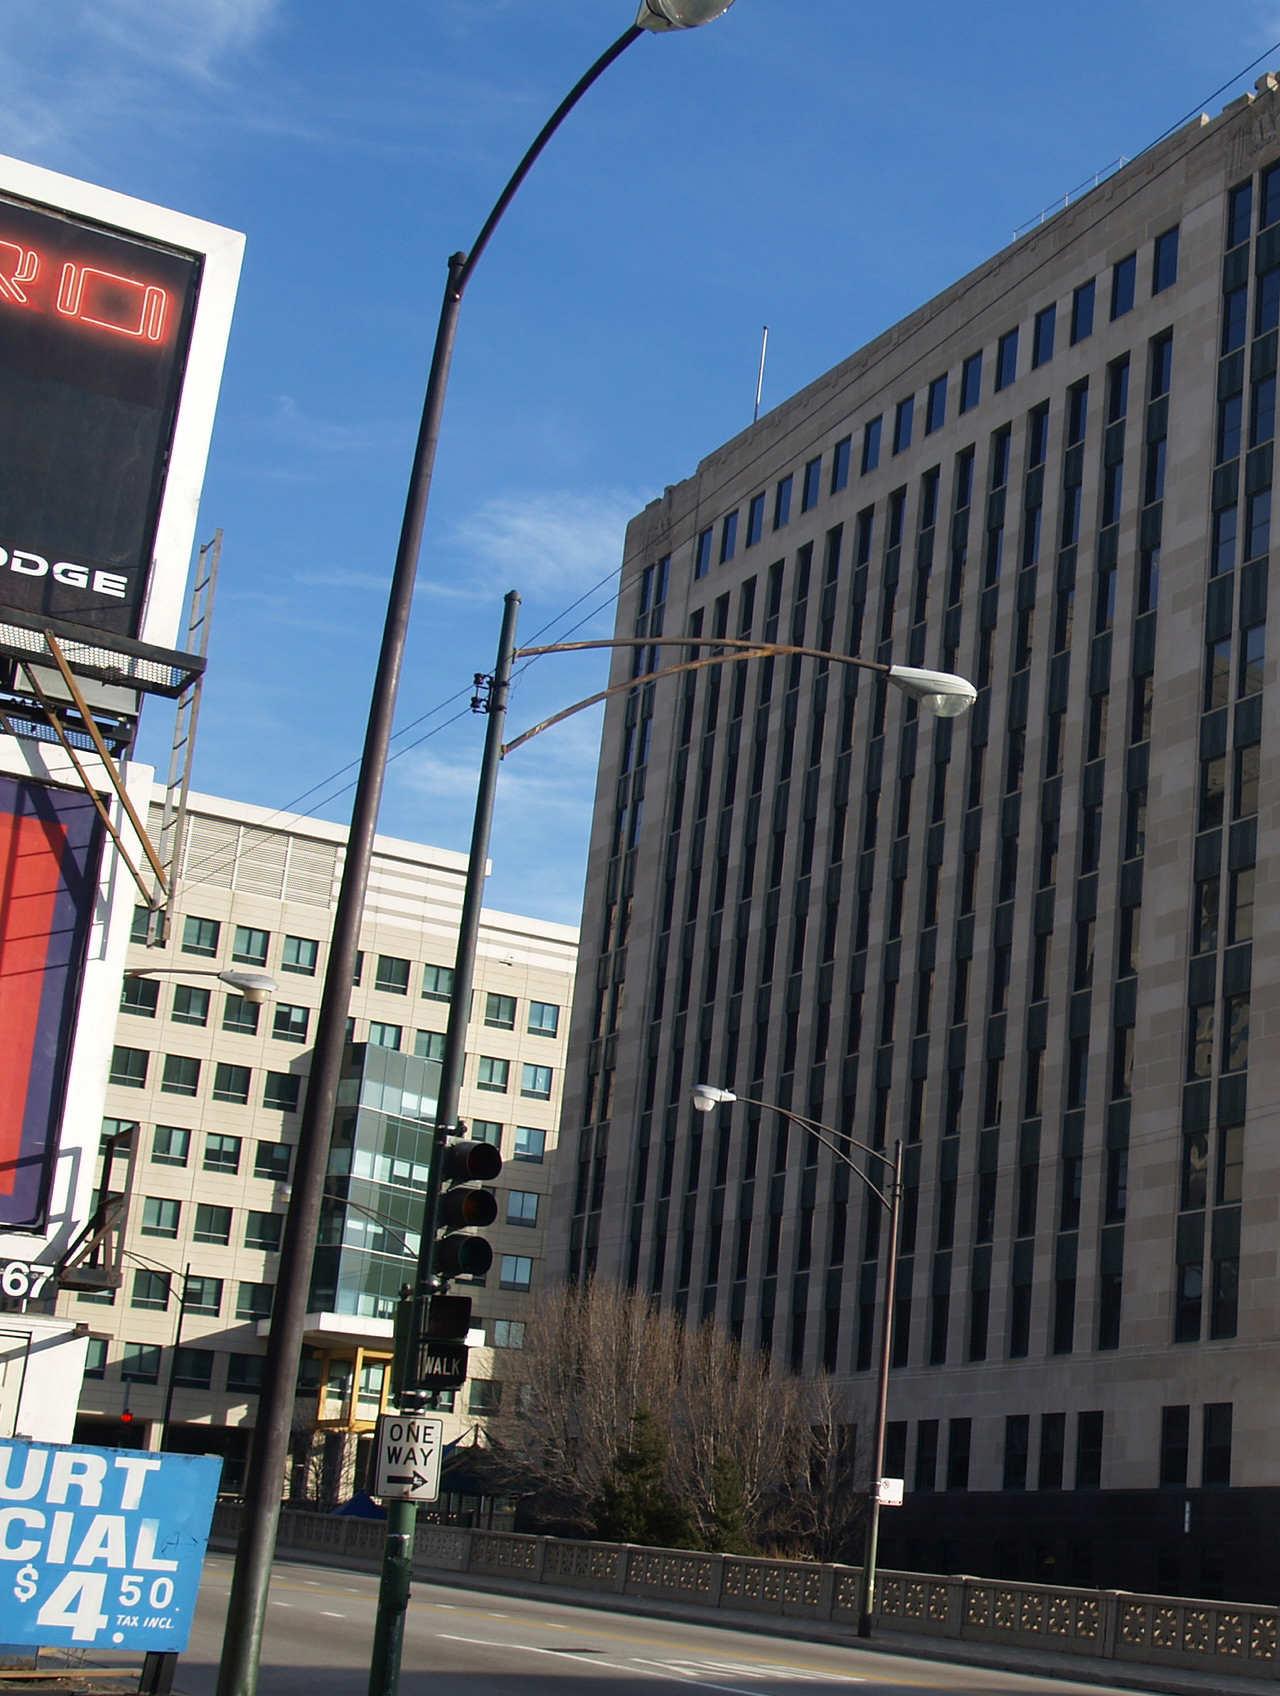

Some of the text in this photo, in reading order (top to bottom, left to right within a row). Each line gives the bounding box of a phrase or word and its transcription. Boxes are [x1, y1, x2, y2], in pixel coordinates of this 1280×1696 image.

[0, 545, 128, 599] DGE
[425, 1356, 461, 1376] WALK
[389, 1423, 435, 1445] ONE
[386, 1446, 434, 1467] WAY
[0, 1446, 162, 1511] URT
[0, 1506, 179, 1572] CIAL
[116, 1614, 140, 1628] TAX
